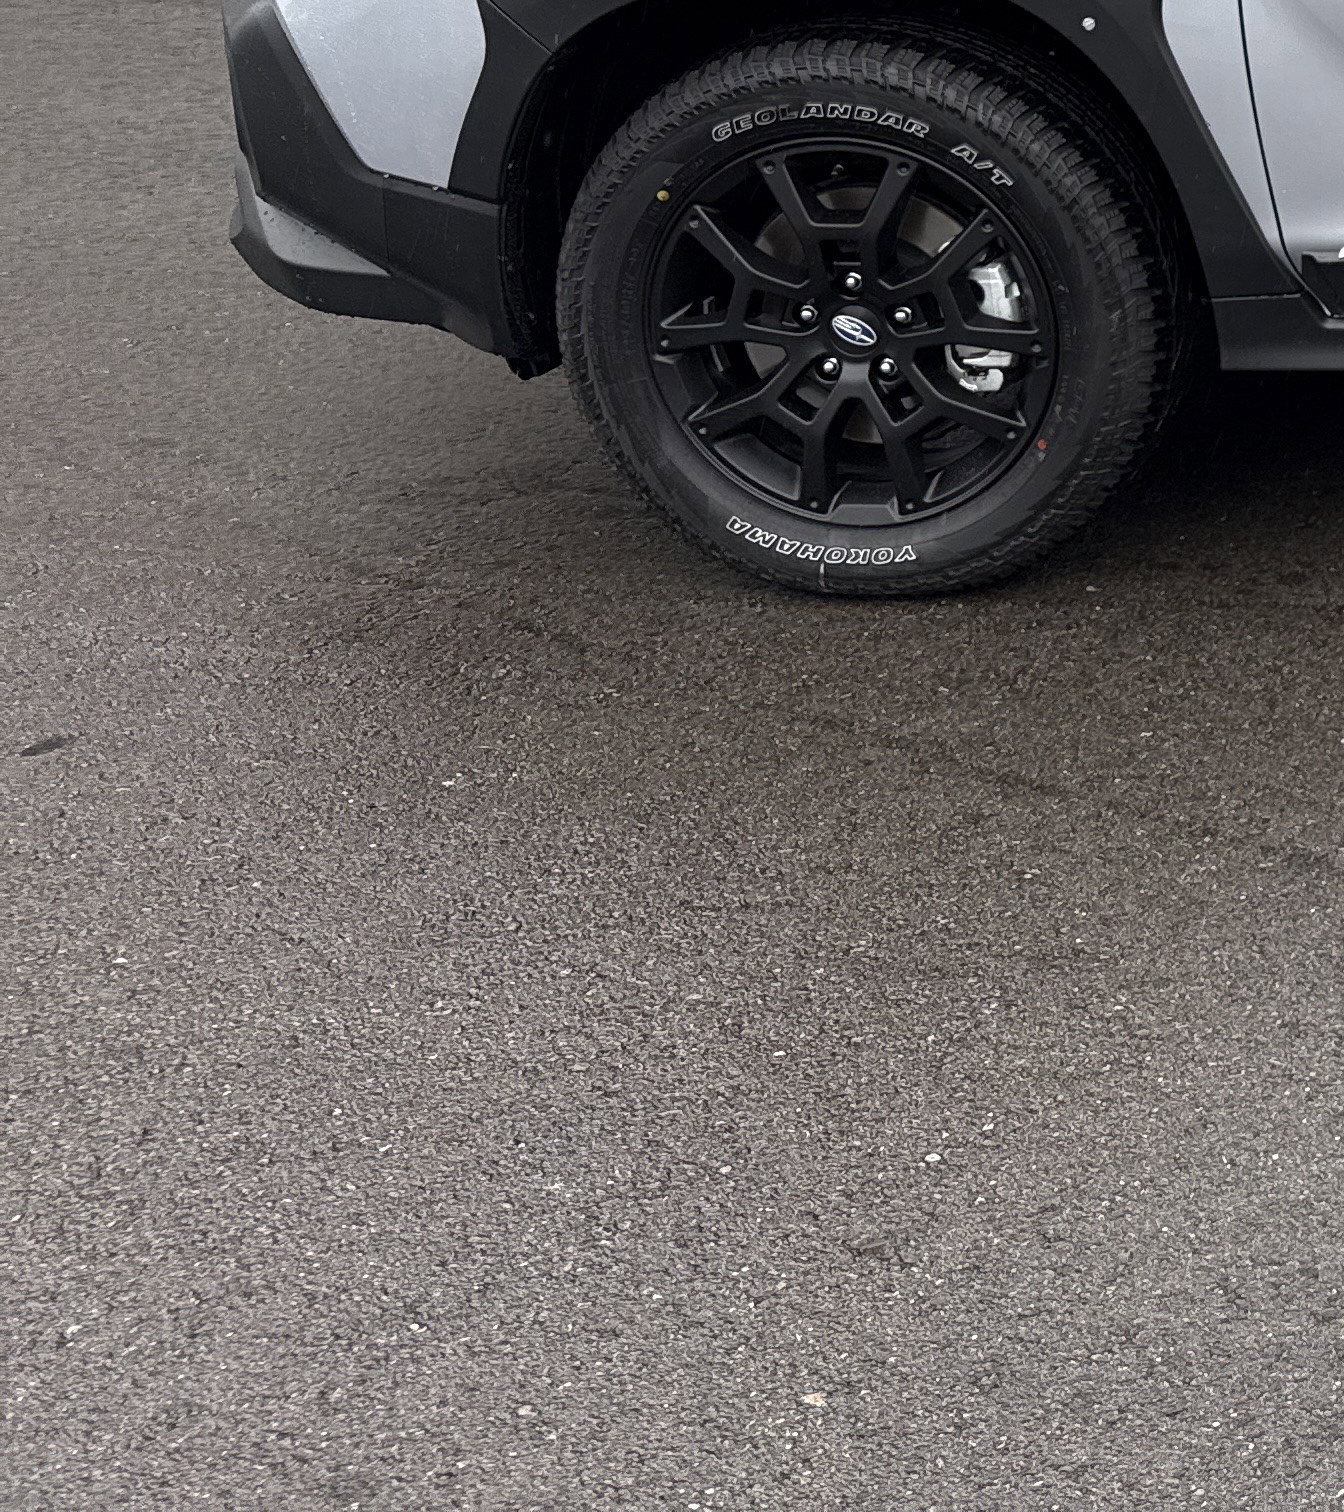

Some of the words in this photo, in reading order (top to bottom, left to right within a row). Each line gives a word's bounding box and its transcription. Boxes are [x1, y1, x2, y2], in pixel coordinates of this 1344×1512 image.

[711, 102, 930, 142] GEOLANDAR
[950, 142, 1014, 187] A/T
[725, 515, 917, 565] YOKOHAMA
